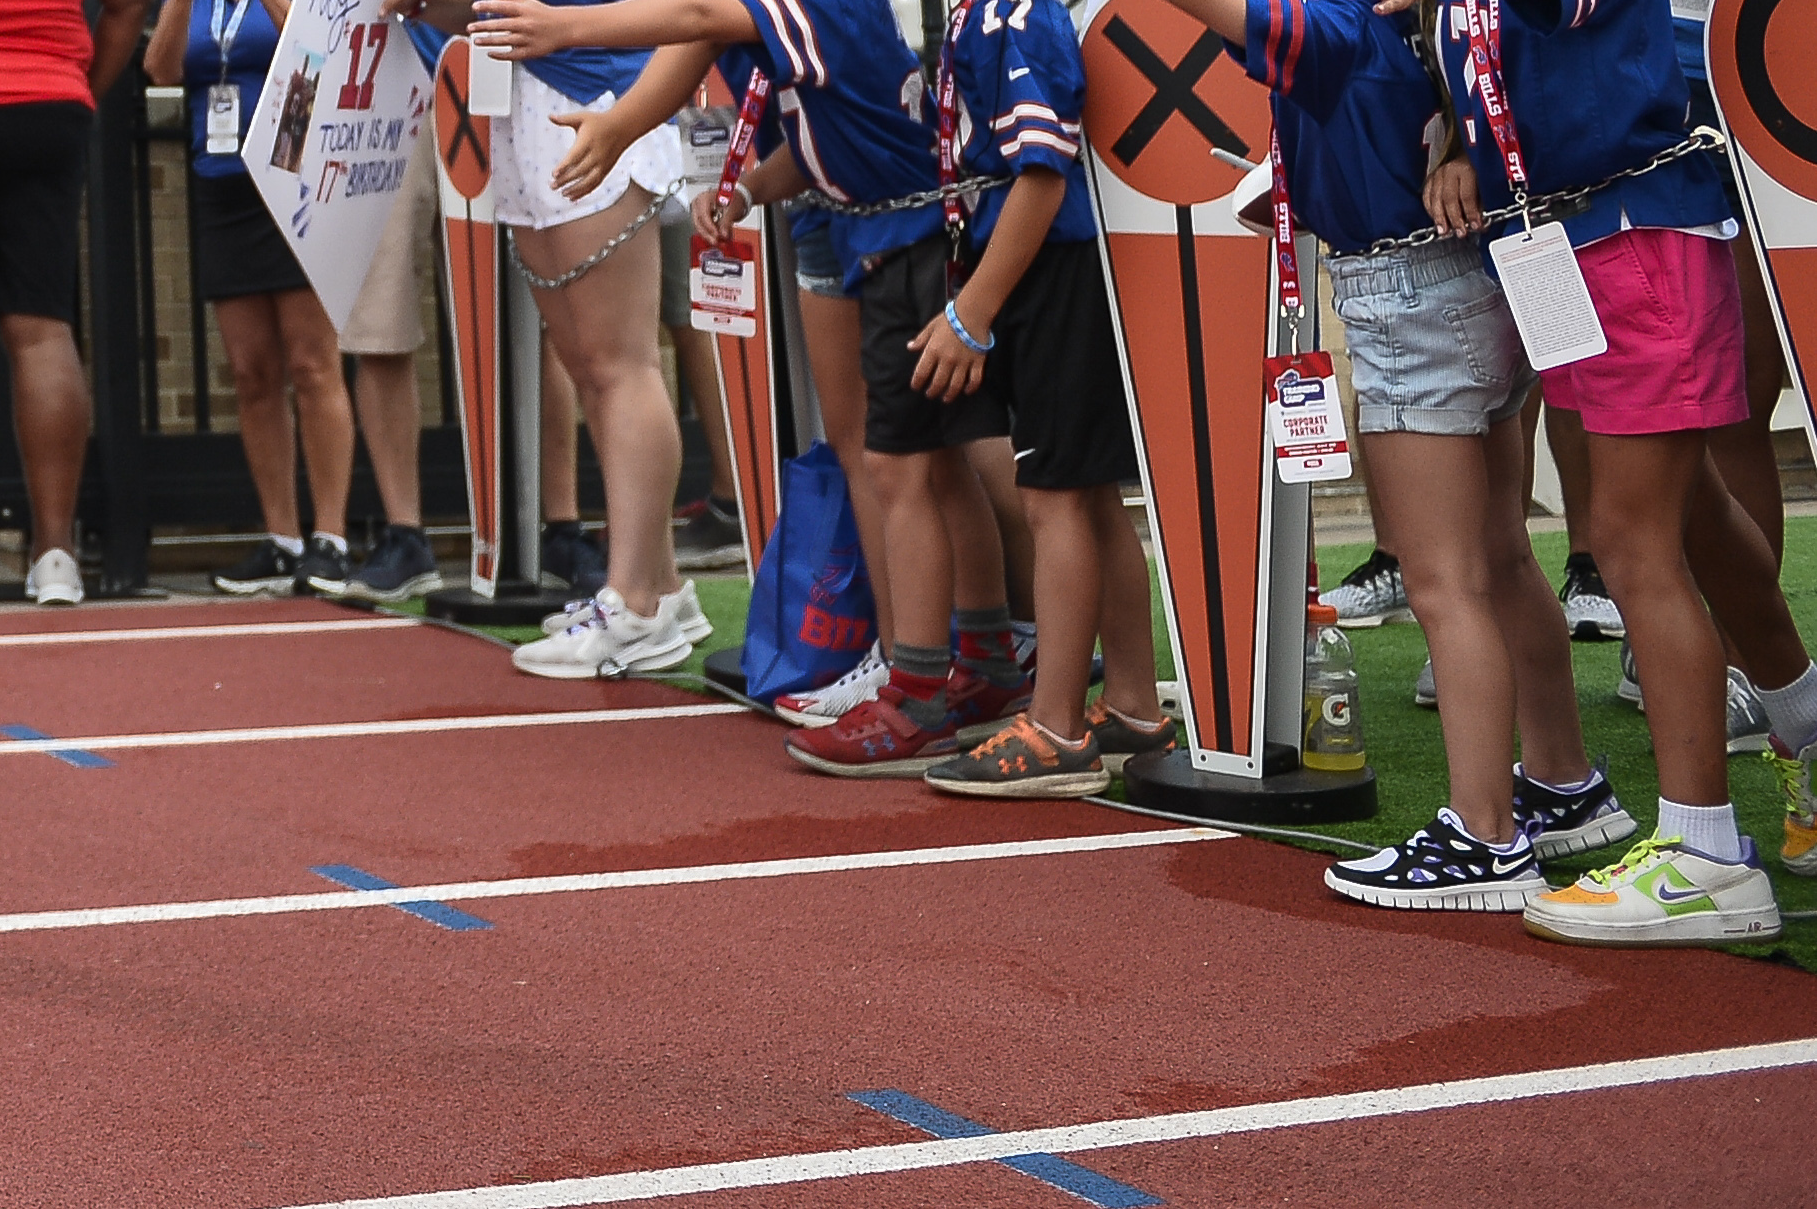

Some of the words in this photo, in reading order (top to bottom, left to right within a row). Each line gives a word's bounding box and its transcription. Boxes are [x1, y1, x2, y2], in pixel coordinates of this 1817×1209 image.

[1478, 72, 1504, 118] BILLS
[320, 122, 365, 153] TODAY
[1278, 202, 1291, 244] BILLS
[1283, 414, 1328, 429] CORPORATE
[1289, 426, 1325, 437] PARTNER
[1321, 692, 1351, 726] G
[1745, 920, 1763, 933] AIR
